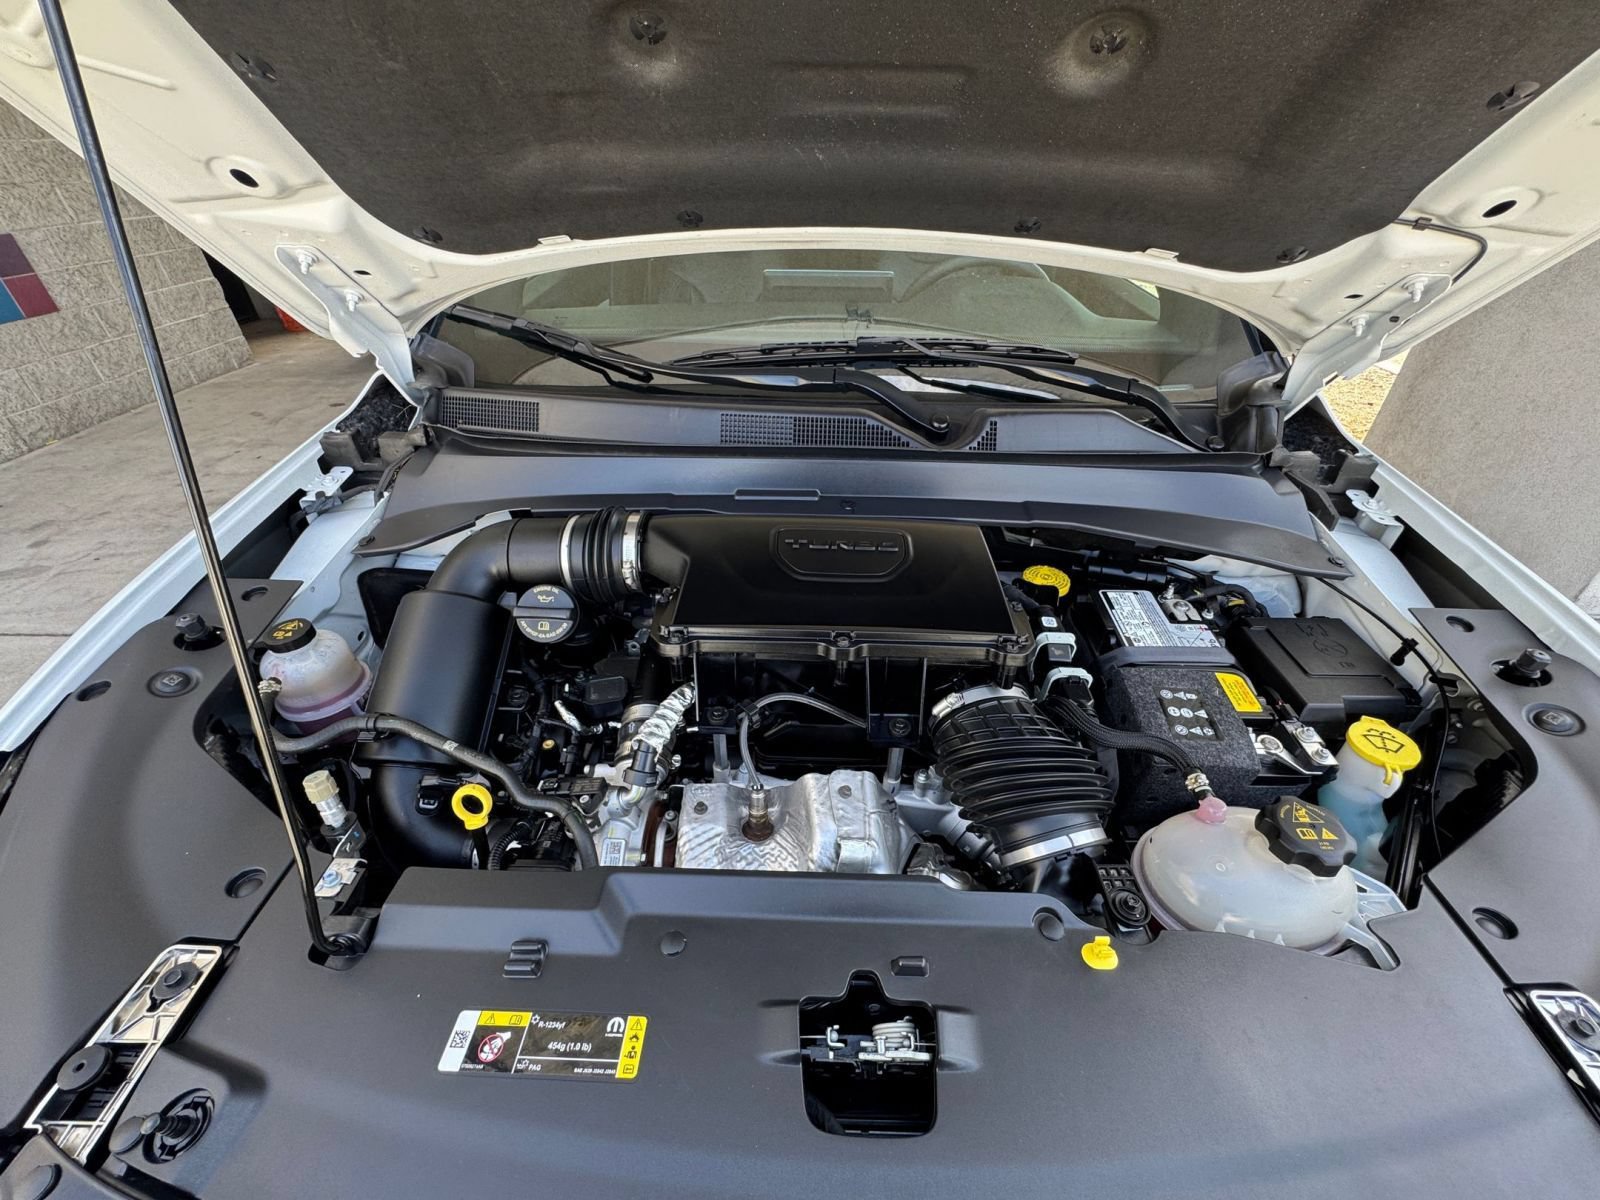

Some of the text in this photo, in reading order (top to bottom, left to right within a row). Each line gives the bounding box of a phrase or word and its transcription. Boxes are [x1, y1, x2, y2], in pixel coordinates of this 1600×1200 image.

[538, 1020, 566, 1031] R-1234yf
[547, 1041, 592, 1053] 454g (1.0 lb)
[528, 1063, 542, 1071] PAG
